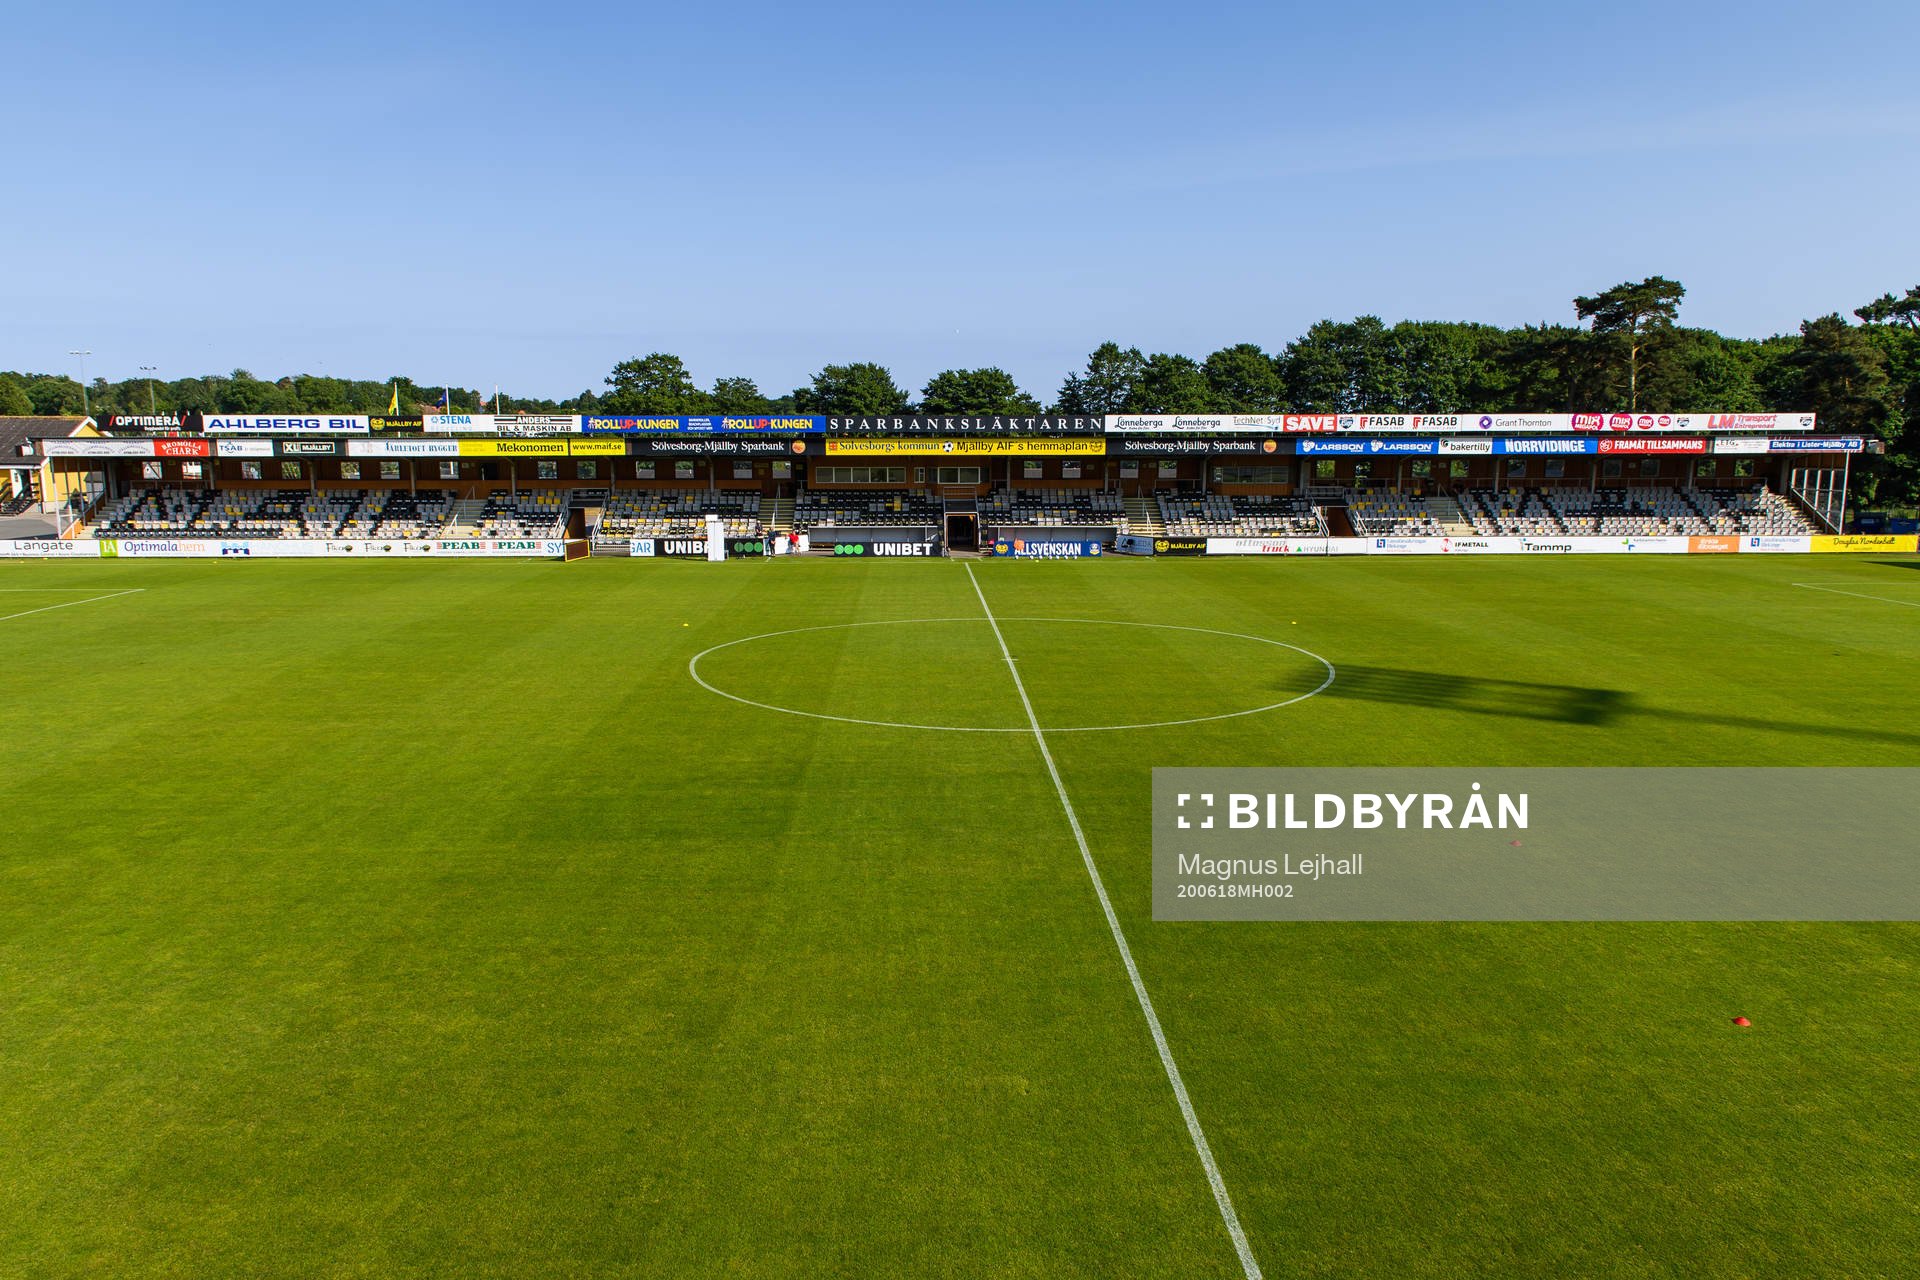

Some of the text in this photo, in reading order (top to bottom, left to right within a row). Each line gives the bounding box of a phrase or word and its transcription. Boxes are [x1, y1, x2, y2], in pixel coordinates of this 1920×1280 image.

[115, 416, 181, 426] OPTIMERA
[208, 419, 365, 429] AHLBERG BIL
[440, 415, 472, 424] STENA
[516, 416, 551, 424] ANDERS
[830, 417, 1102, 430] SPARBANKSLÄKTAREN
[1114, 416, 1163, 430] Lönneberga
[1172, 416, 1221, 430] Lönneberga
[1233, 416, 1263, 424] TechNet
[1286, 417, 1335, 431] SAVE
[1369, 416, 1405, 426] FASAB
[1422, 416, 1458, 426] FASAB
[1495, 418, 1552, 427] Grant Thornton
[1707, 415, 1736, 428] LM
[285, 443, 300, 452] XL
[497, 443, 564, 452] Mekonomen
[652, 441, 785, 452] Sölvesborg-Mjällby Sparbank
[897, 441, 940, 449] kommun
[1027, 441, 1088, 452] hemmaplan
[1125, 440, 1256, 452] Sölvesborg-Mjällby Sparbank
[1450, 442, 1491, 452] bakertilly
[1505, 439, 1586, 452] NORRVIDINGE
[1647, 440, 1703, 449] TILLSAMMANS
[166, 447, 199, 455] CHARK
[14, 541, 73, 552] Langate
[442, 542, 480, 550] PEAB
[498, 541, 536, 549] PEAB
[873, 543, 933, 556] UNIBET
[1524, 543, 1572, 552] Tammp
